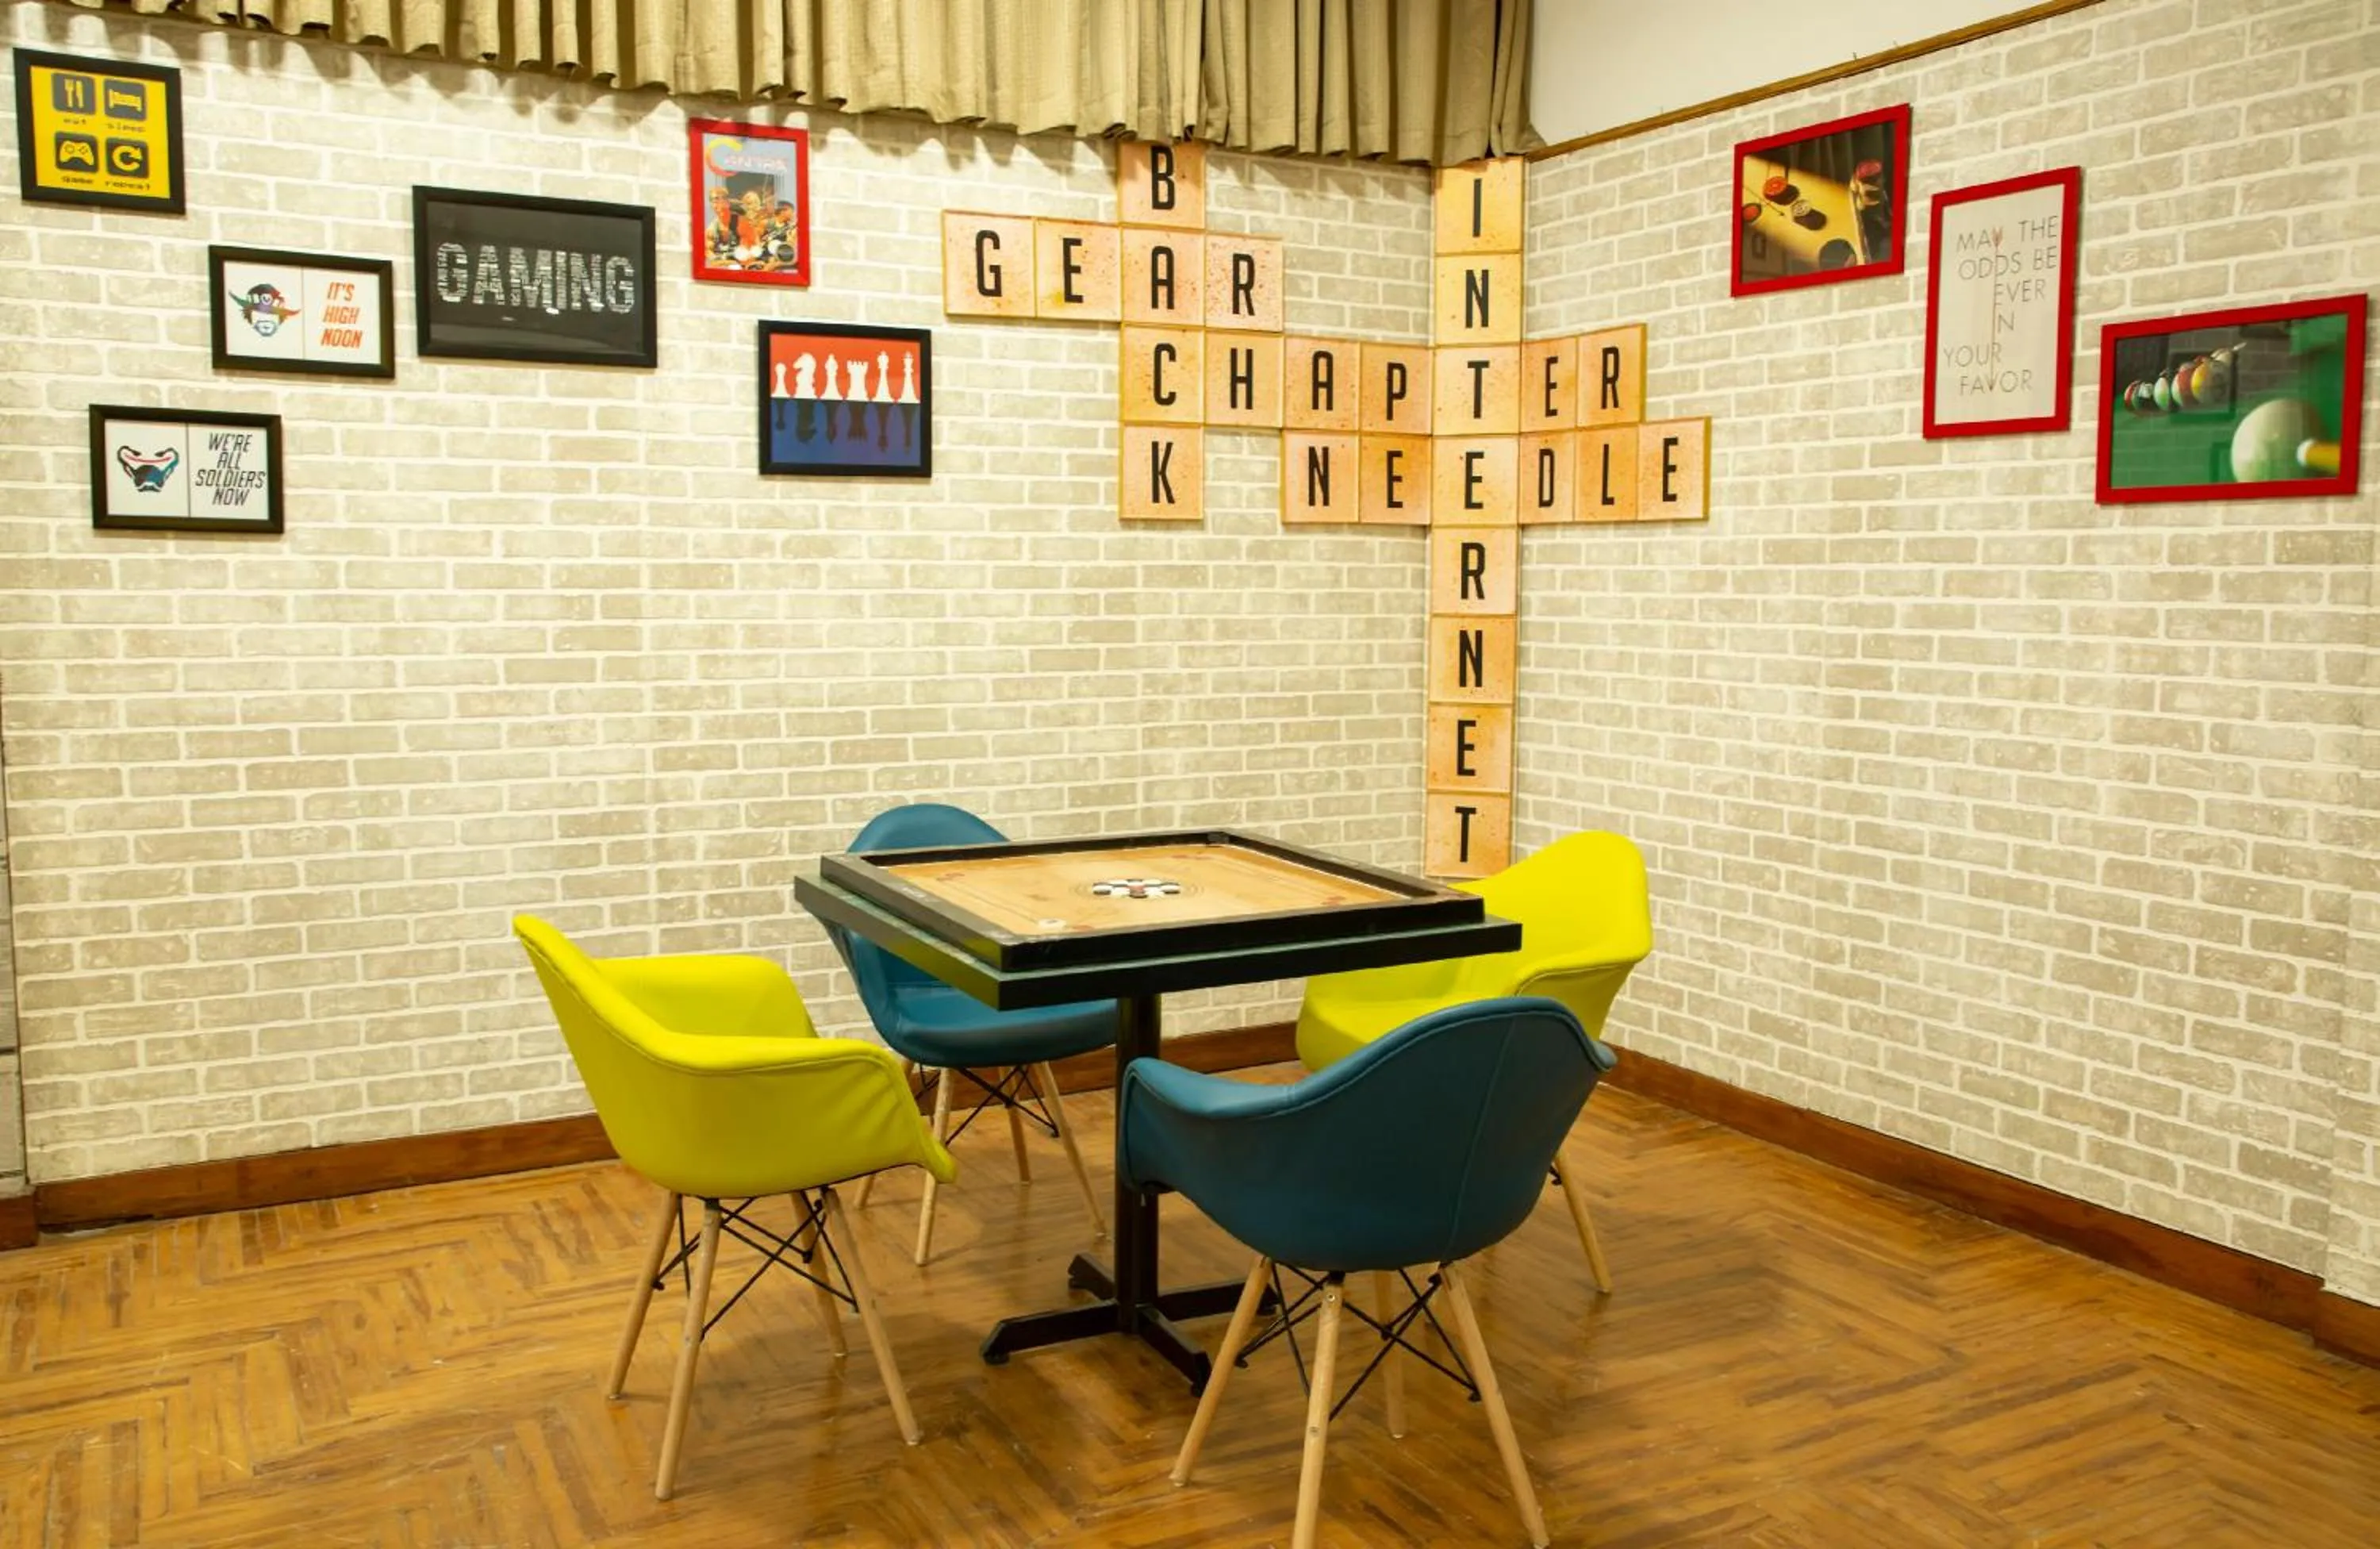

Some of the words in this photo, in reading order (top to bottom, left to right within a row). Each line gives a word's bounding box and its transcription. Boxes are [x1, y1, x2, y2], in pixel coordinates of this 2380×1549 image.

[2018, 215, 2059, 242] THE
[975, 229, 1255, 316] GEAR
[1958, 251, 2022, 280] ODDS
[2033, 245, 2058, 271] BE
[437, 242, 635, 314] GAMING
[327, 282, 355, 302] IT'S
[1993, 279, 2047, 306] EVER
[322, 305, 361, 325] HIGH
[1150, 145, 1177, 505] BACK
[321, 327, 363, 349] NOON
[1943, 341, 2002, 368] YOUR
[1154, 342, 1620, 421] CHAPTER
[1960, 369, 2033, 396] FAVOR
[208, 432, 253, 452] WE'RE
[217, 452, 242, 470] ALL
[1307, 436, 1679, 509] NEEDLE
[194, 469, 267, 489] SOLDIERS
[212, 487, 251, 506] NOW
[1454, 178, 1491, 863] INTERNET
